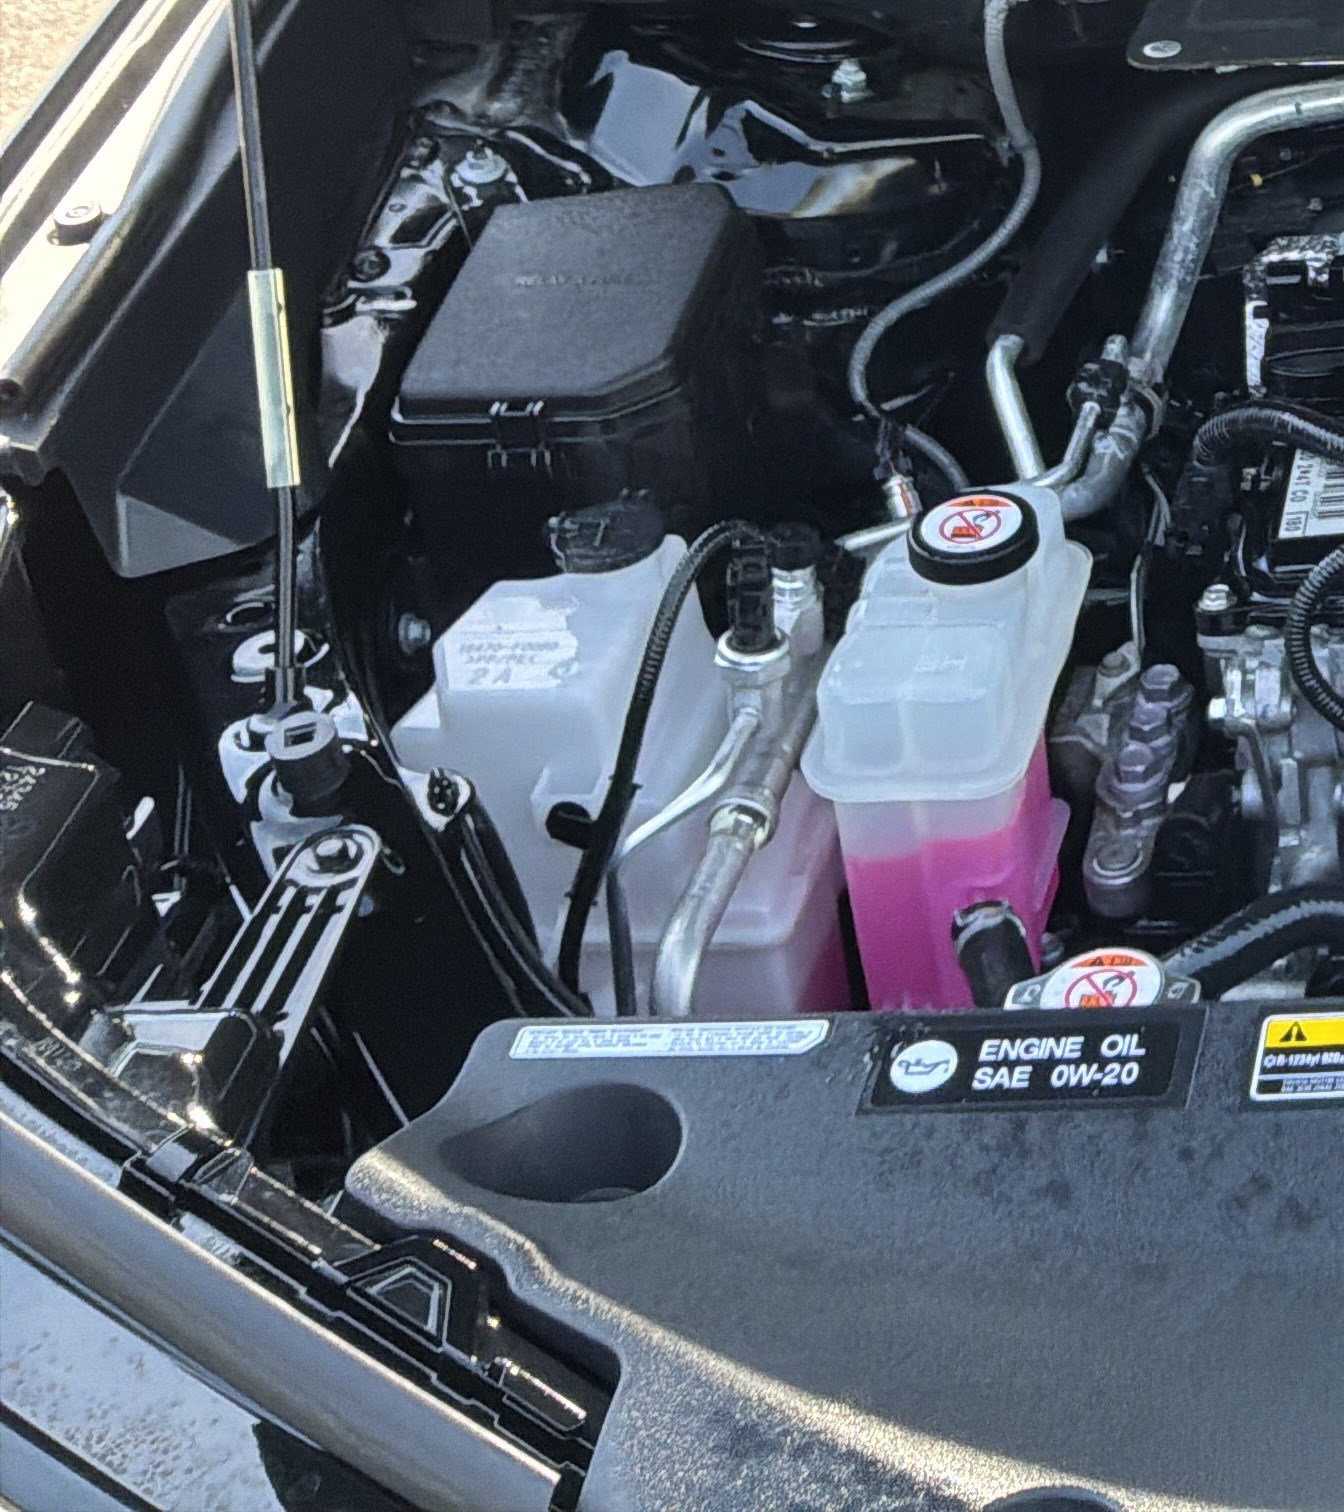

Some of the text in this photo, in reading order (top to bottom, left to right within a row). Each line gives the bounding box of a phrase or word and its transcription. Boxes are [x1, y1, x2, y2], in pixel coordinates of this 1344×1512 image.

[978, 1033, 1147, 1062] ENGINE OIL
[971, 1062, 1140, 1090] SAE 0W-20
